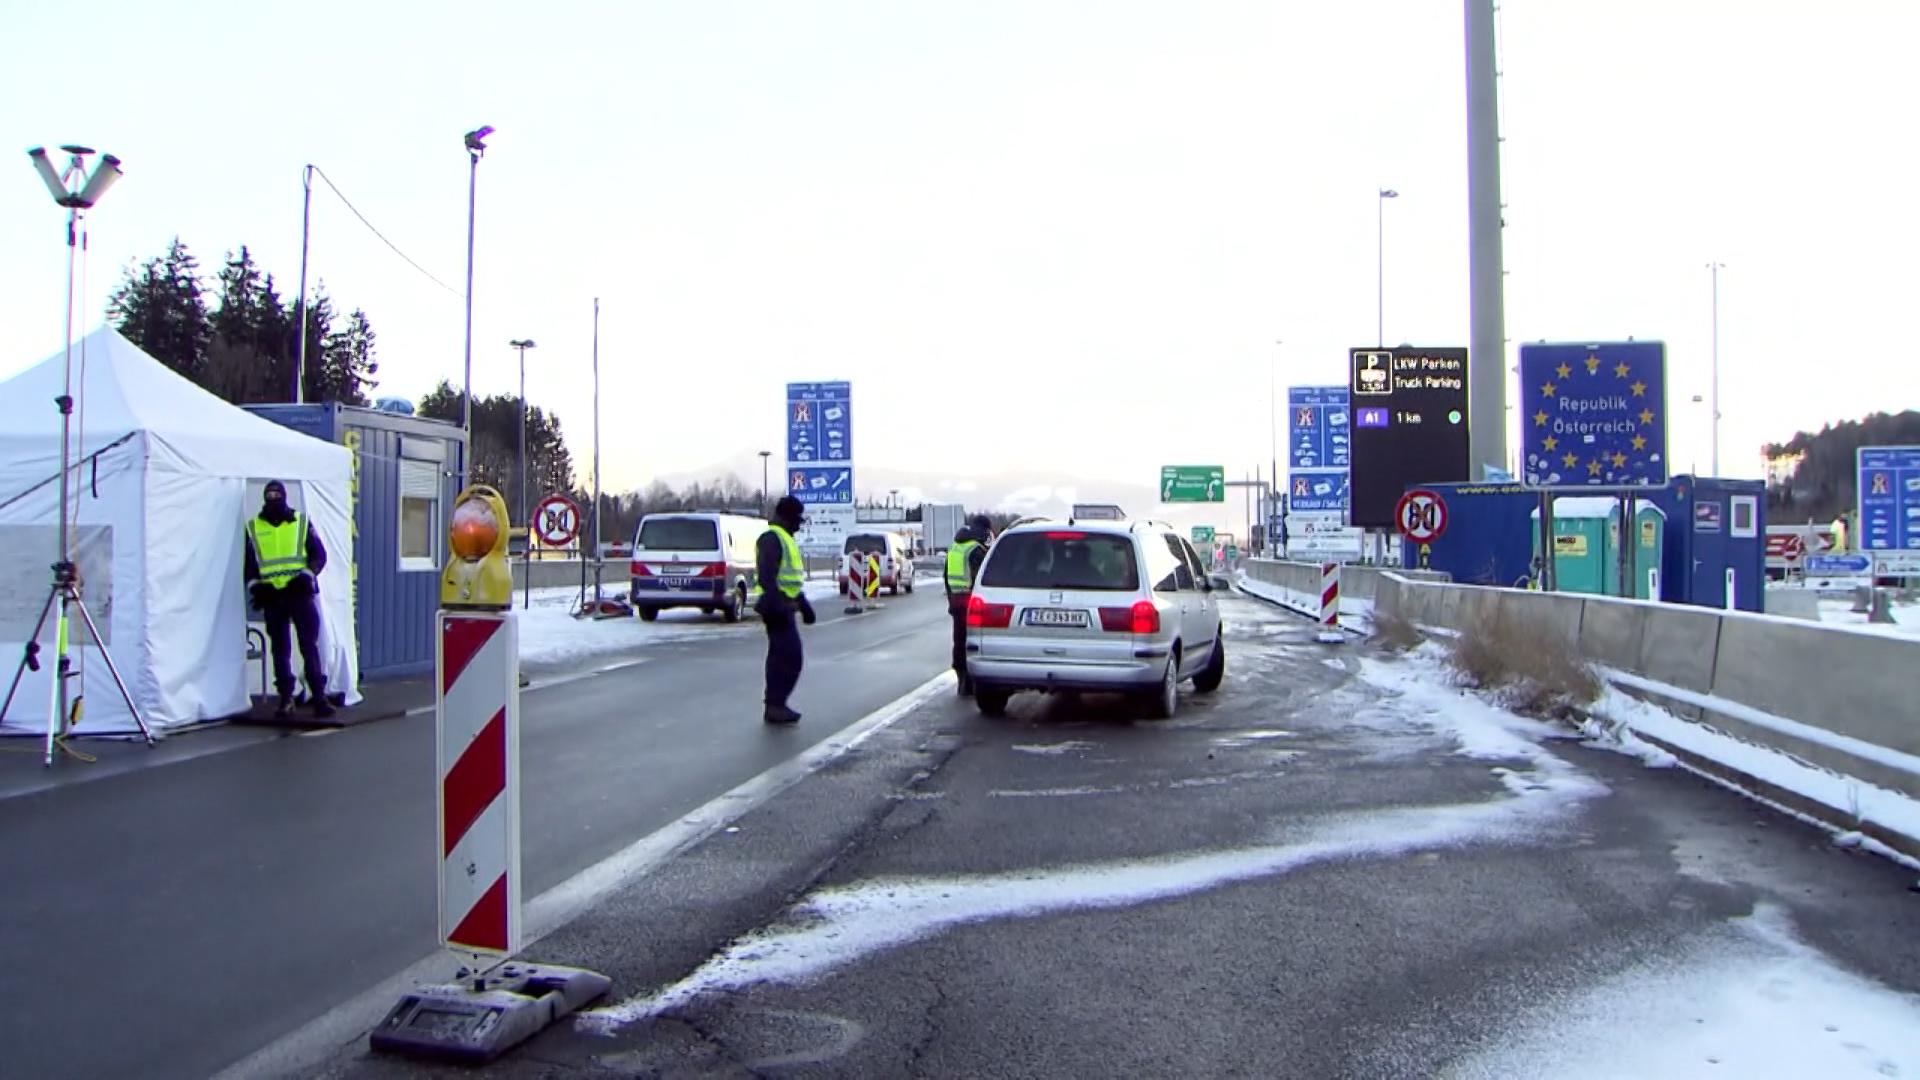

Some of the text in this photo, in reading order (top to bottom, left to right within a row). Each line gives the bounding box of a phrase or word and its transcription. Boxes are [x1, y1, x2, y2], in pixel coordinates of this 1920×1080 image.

[1394, 357, 1460, 370] LKW Parken
[1394, 376, 1462, 390] Truck Parking
[1559, 396, 1628, 414] Republik
[1365, 410, 1422, 424] A1 1 km
[1553, 417, 1636, 434] Österreich
